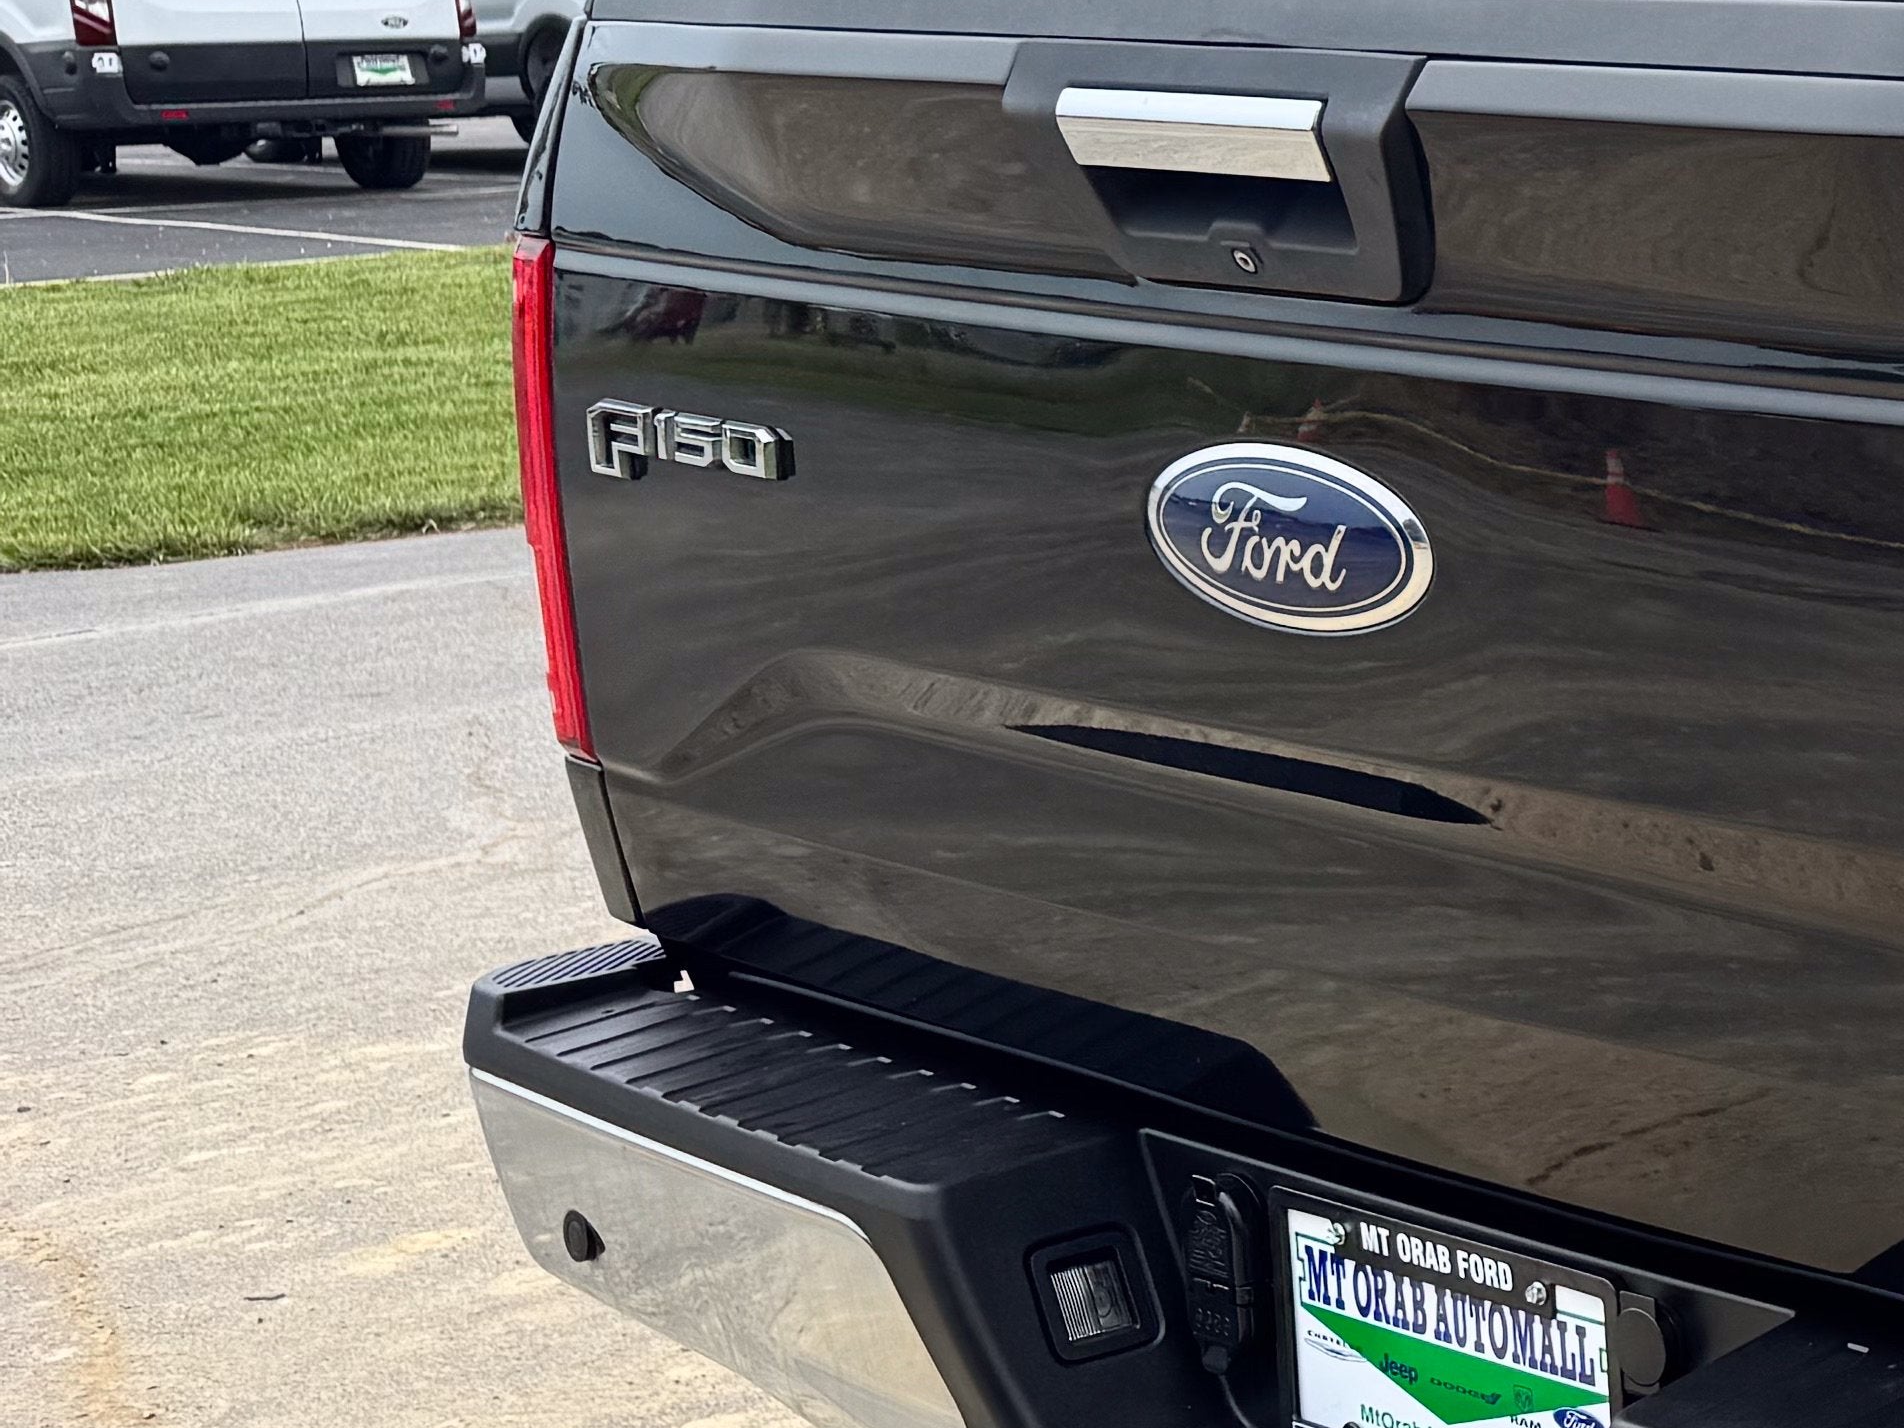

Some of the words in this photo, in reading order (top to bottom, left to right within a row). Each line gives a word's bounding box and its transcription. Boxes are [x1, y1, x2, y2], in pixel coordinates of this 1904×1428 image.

[1200, 481, 1347, 592] Ford
[1359, 1221, 1390, 1257] MT
[1396, 1232, 1452, 1274] ORAB
[1456, 1249, 1514, 1292] FORD
[1303, 1244, 1346, 1311] MT
[1352, 1262, 1428, 1335] ORAB
[1434, 1288, 1596, 1387] AUTOMALL
[1379, 1352, 1419, 1386] Jeep
